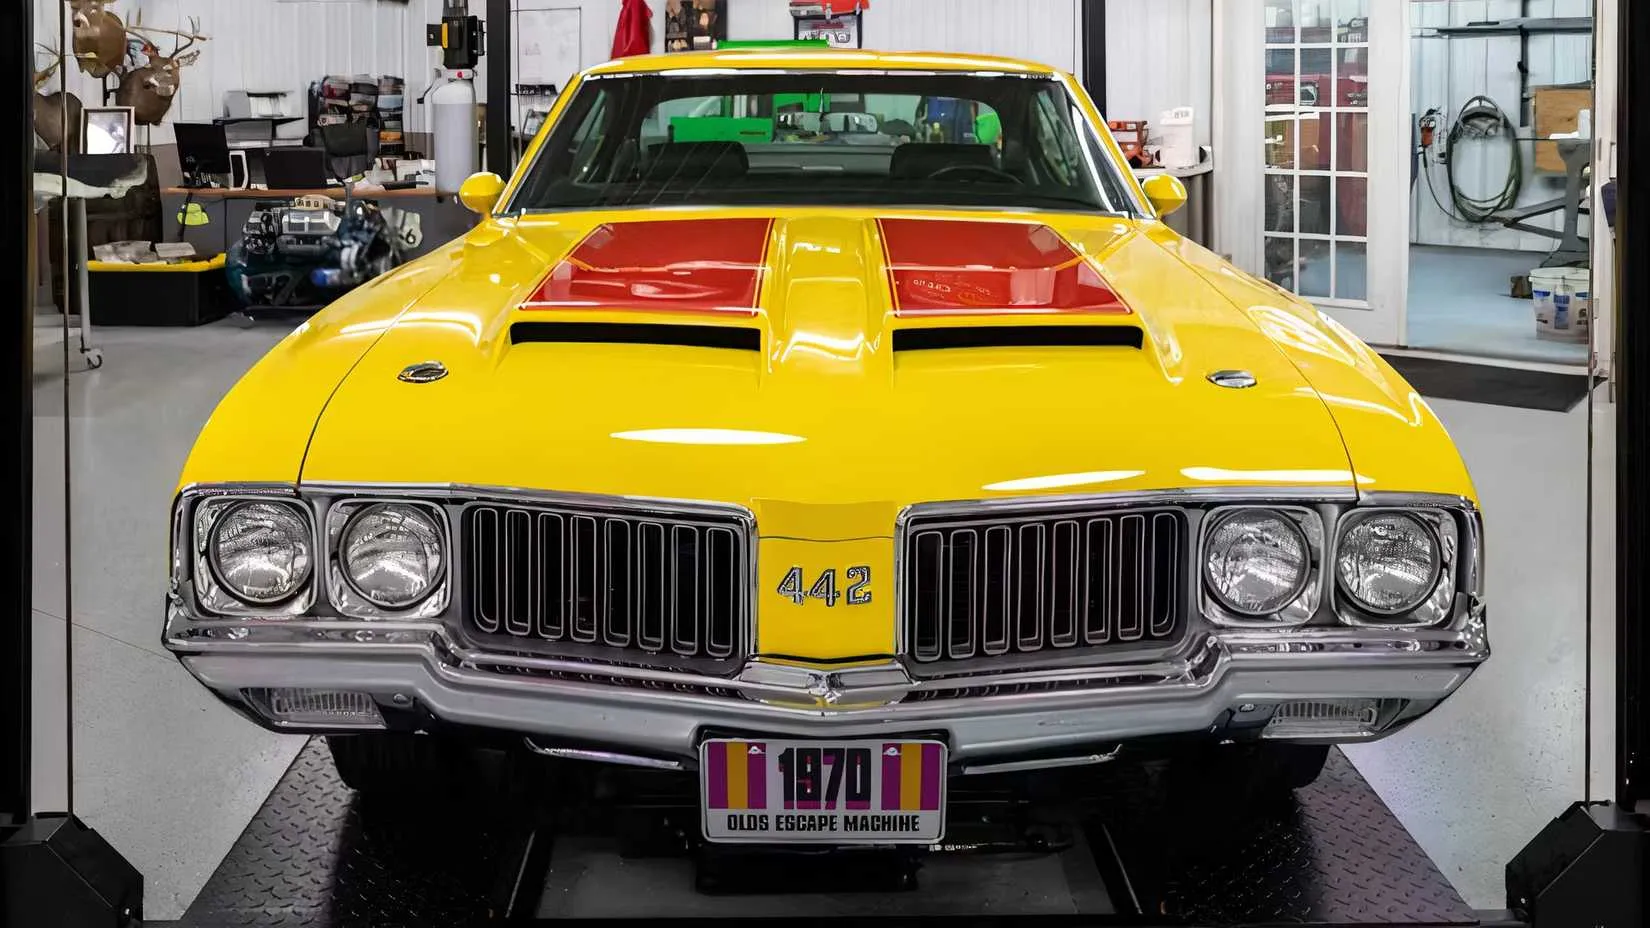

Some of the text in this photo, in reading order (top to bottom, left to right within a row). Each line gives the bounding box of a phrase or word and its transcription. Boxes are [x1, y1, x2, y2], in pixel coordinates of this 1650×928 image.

[777, 566, 872, 608] 442
[778, 747, 872, 810] 1970
[727, 814, 920, 832] OLDS ESCAPE MACHINE
